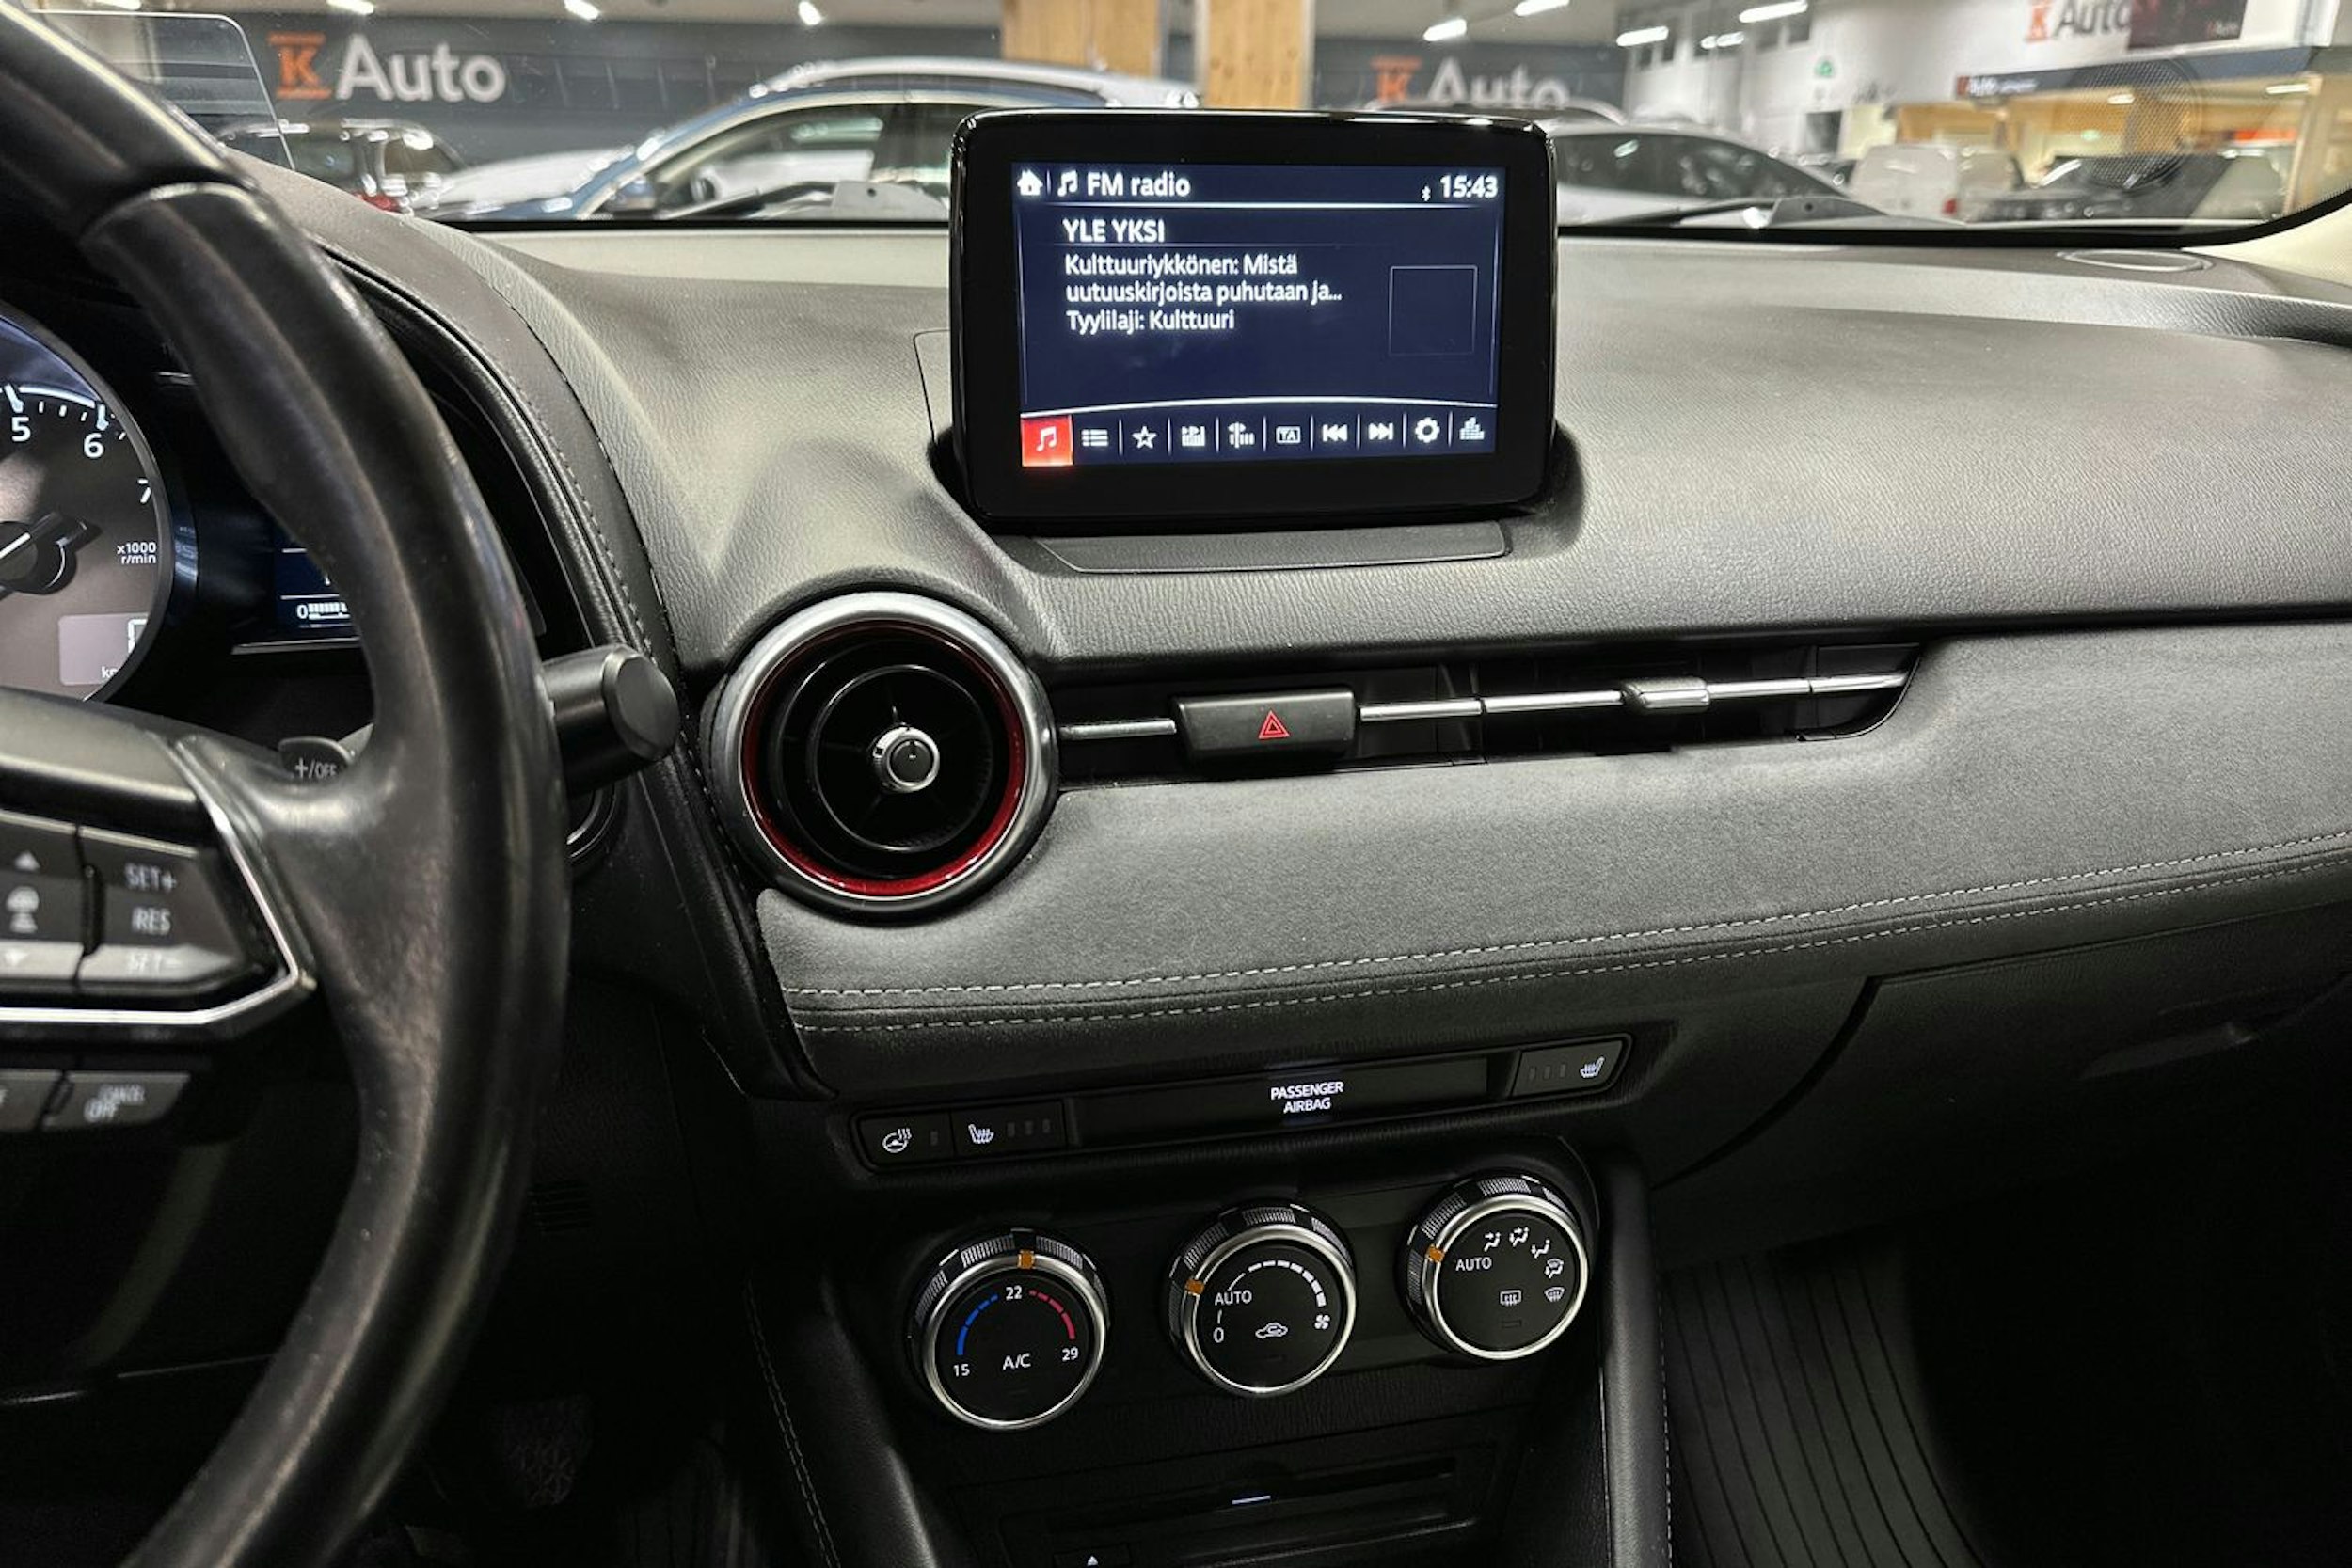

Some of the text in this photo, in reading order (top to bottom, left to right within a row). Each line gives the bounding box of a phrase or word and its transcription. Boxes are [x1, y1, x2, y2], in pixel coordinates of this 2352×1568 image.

[2051, 0, 2132, 39] Auto
[336, 33, 505, 102] Auto
[1428, 56, 1570, 109] Auto
[1087, 172, 1191, 197] FM radio
[1440, 176, 1498, 198] 15:43
[1063, 219, 1165, 243] YLE YKSI
[1065, 253, 1297, 279] Kulttuuriykkönen: Mistä
[1066, 281, 1342, 308] uutuuskirjoista puhutaan ja...
[1066, 309, 1235, 334] Tyylilaji: Kulttuuri
[11, 417, 31, 442] 5
[84, 434, 103, 458] 6
[117, 542, 156, 554] x1000
[121, 553, 156, 564] r/min
[124, 863, 177, 893] SET+
[132, 907, 171, 935] RES
[1270, 1081, 1344, 1101] PASSENGER
[1283, 1097, 1332, 1114] AIRBAG
[1455, 1257, 1492, 1272] AUTO
[1005, 1286, 1023, 1300] 22
[1215, 1290, 1253, 1306] AUTO
[1214, 1328, 1224, 1343] 0
[1002, 1353, 1032, 1370] A/C
[1061, 1347, 1079, 1362] 29
[953, 1363, 971, 1377] 15
